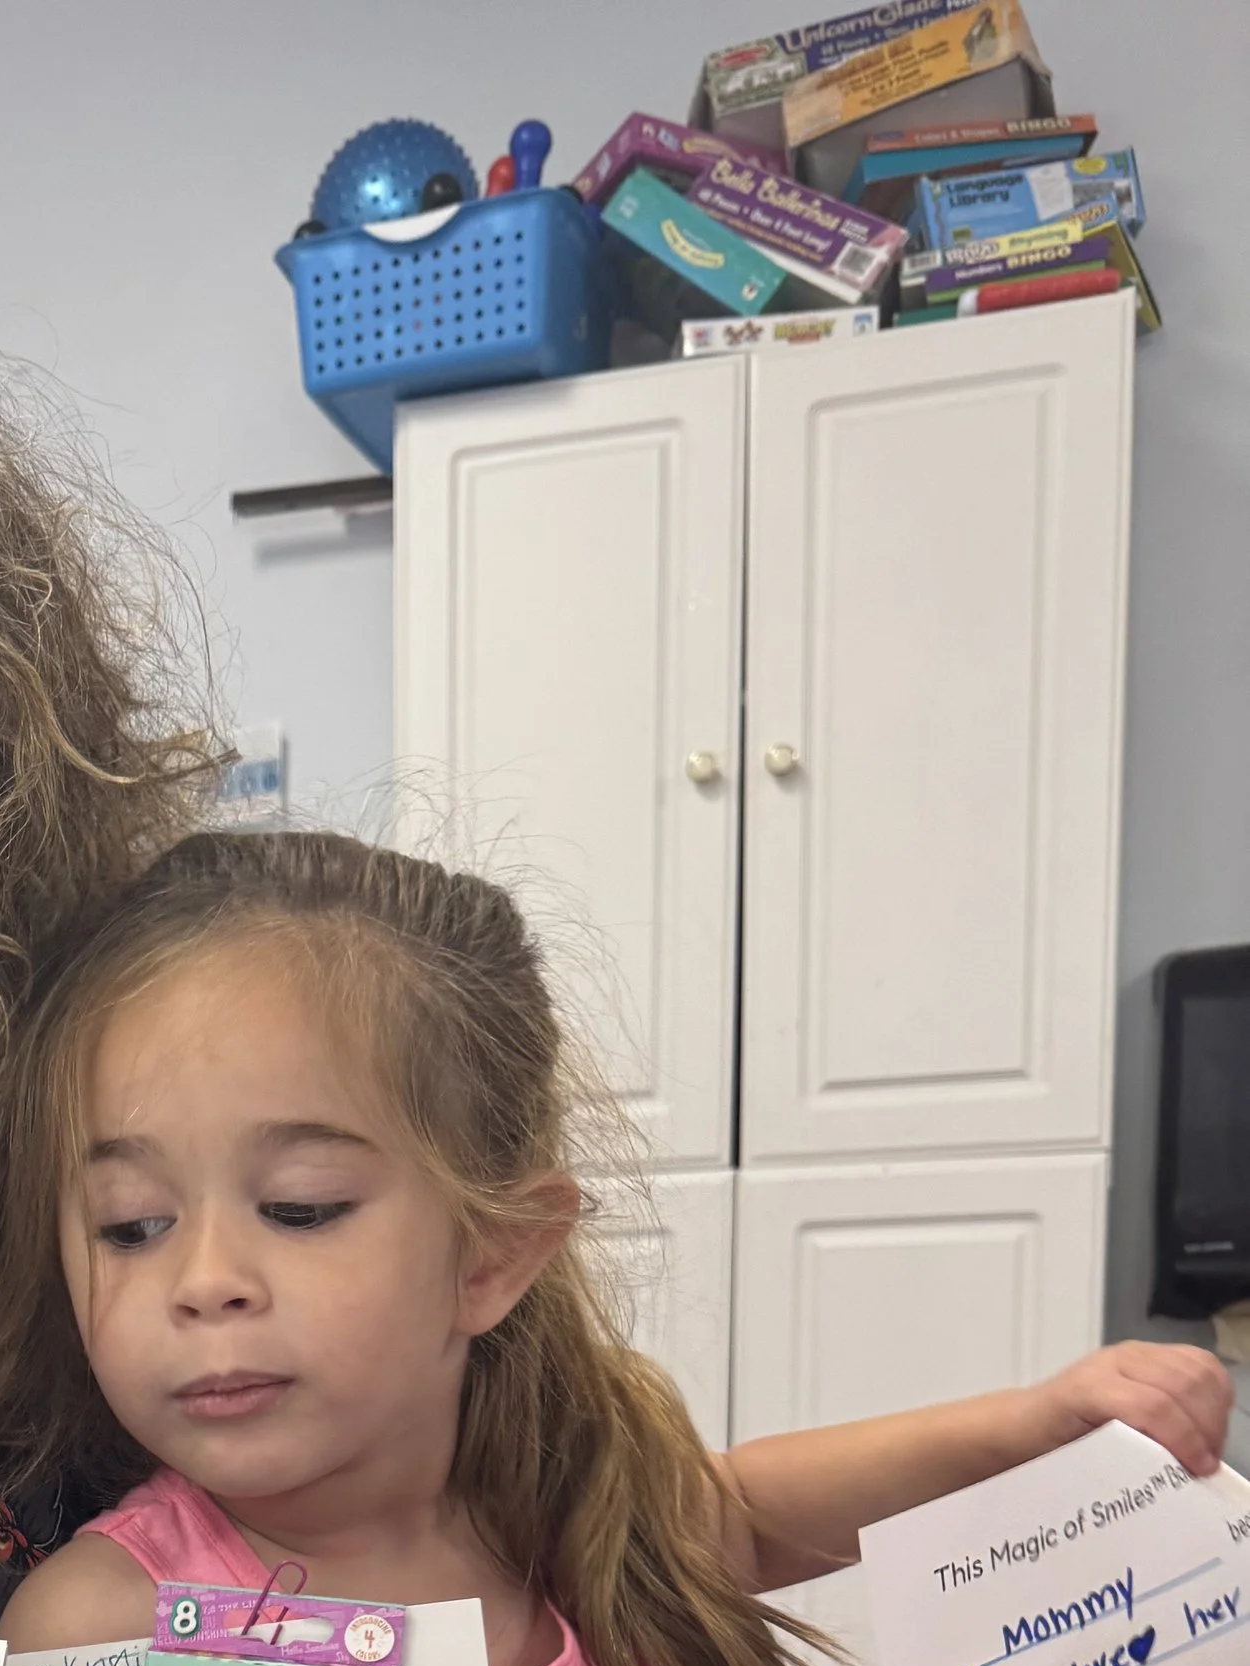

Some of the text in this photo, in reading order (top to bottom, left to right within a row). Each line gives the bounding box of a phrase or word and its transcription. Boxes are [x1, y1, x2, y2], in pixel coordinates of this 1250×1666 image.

[1006, 117, 1072, 133] BINGO
[946, 172, 1025, 193] Language
[950, 188, 1011, 208] Library
[1006, 245, 1072, 269] BINGO
[934, 1555, 984, 1592] This
[989, 1526, 1059, 1571] Magic
[1063, 1512, 1088, 1540] of
[172, 1600, 198, 1635] 8
[1001, 1566, 1135, 1657] Mommy
[1183, 1586, 1242, 1638] her
[364, 1629, 376, 1649] 4
